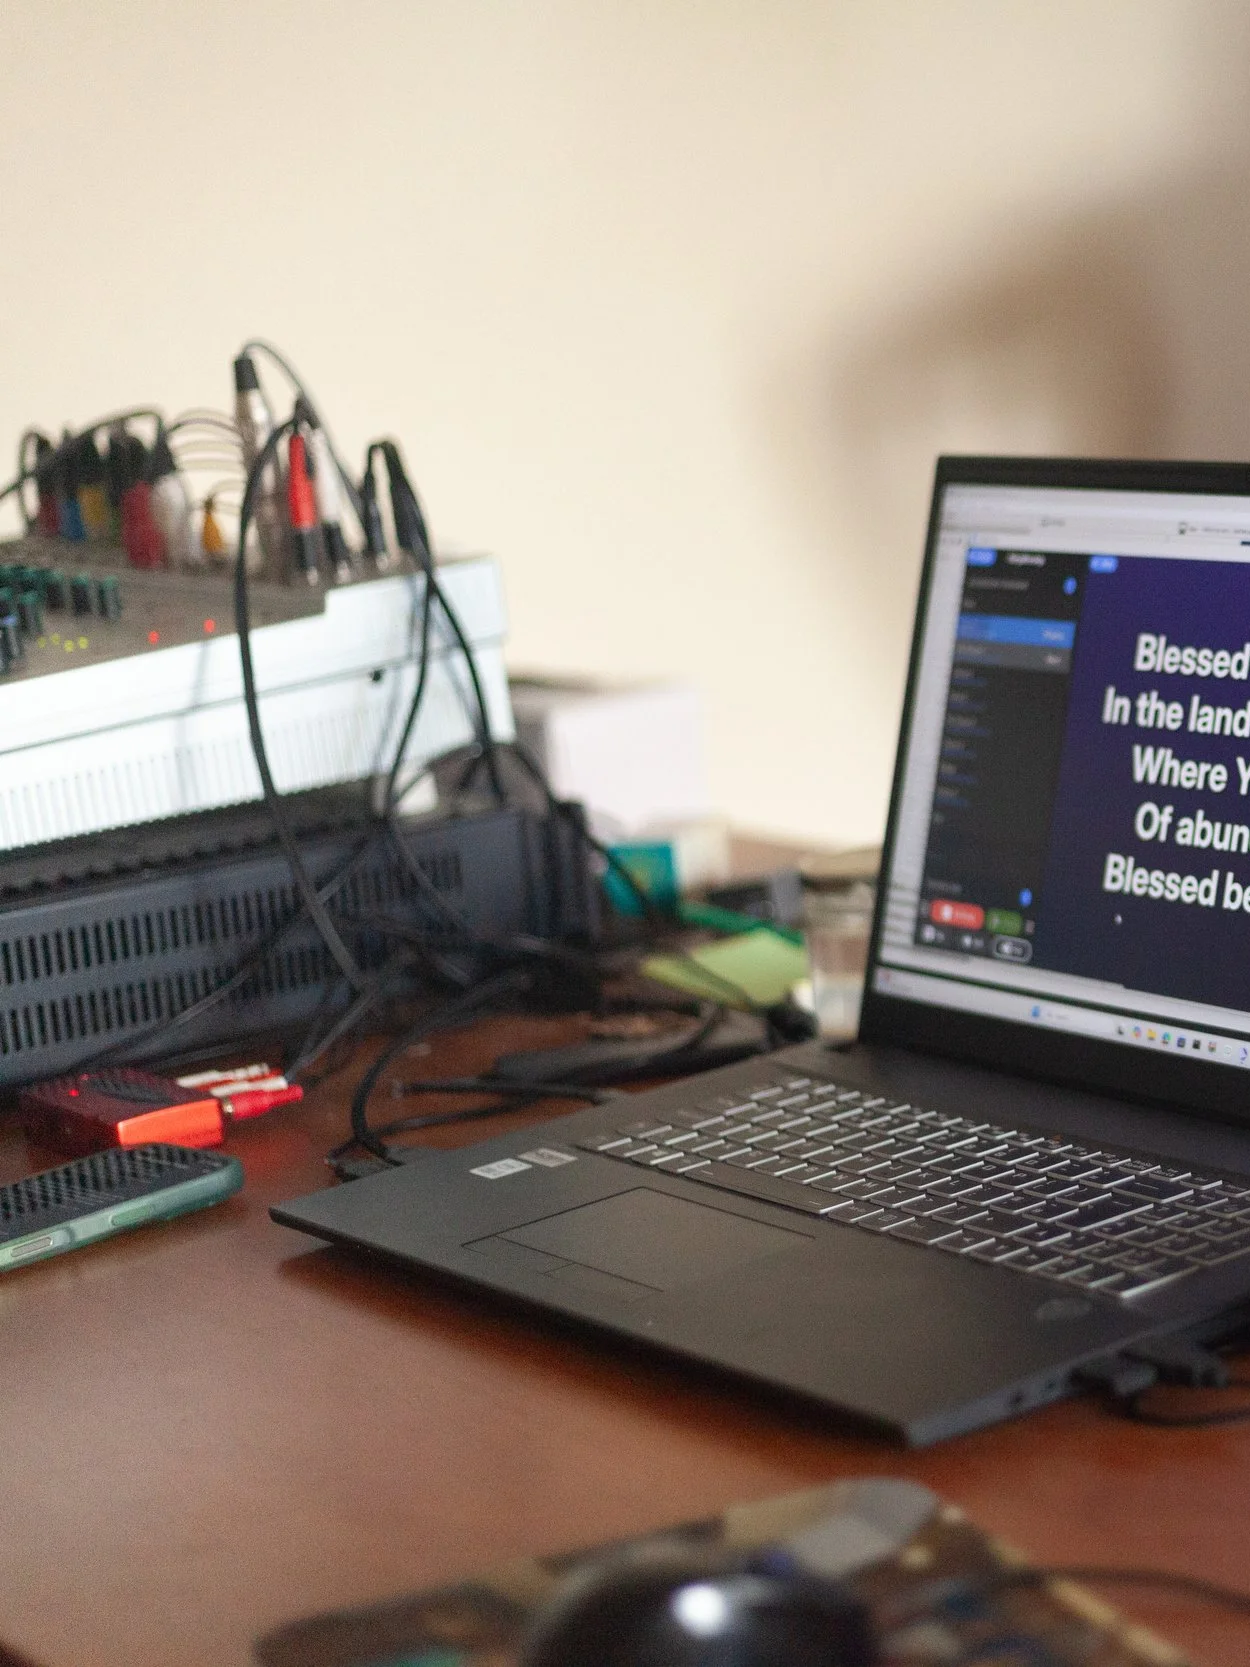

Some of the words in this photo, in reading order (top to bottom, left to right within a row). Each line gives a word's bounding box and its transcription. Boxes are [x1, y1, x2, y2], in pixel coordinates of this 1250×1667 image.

[1102, 685, 1131, 725] In
[1136, 689, 1184, 731] the
[1132, 744, 1228, 794] Where
[1135, 800, 1174, 842] Of
[1103, 852, 1220, 908] Blessed
